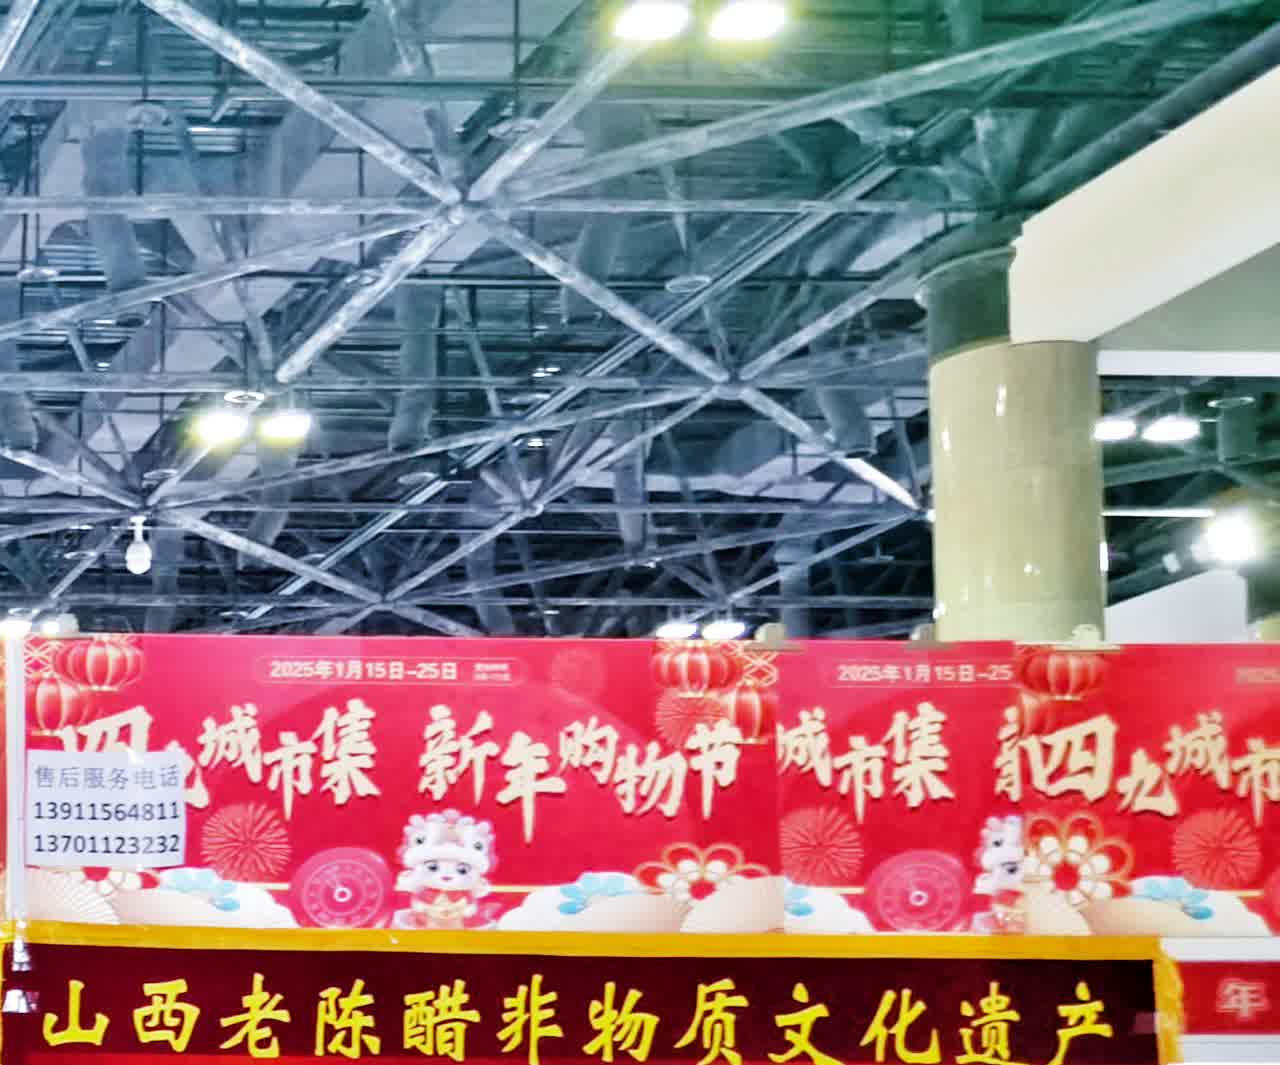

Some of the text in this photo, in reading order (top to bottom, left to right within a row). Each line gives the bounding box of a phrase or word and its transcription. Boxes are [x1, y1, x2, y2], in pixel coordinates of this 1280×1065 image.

[34, 764, 180, 790] 售后服务电话
[418, 704, 742, 842] 新年购物节
[34, 801, 180, 821] 13911564811
[34, 834, 180, 854] 13701123232
